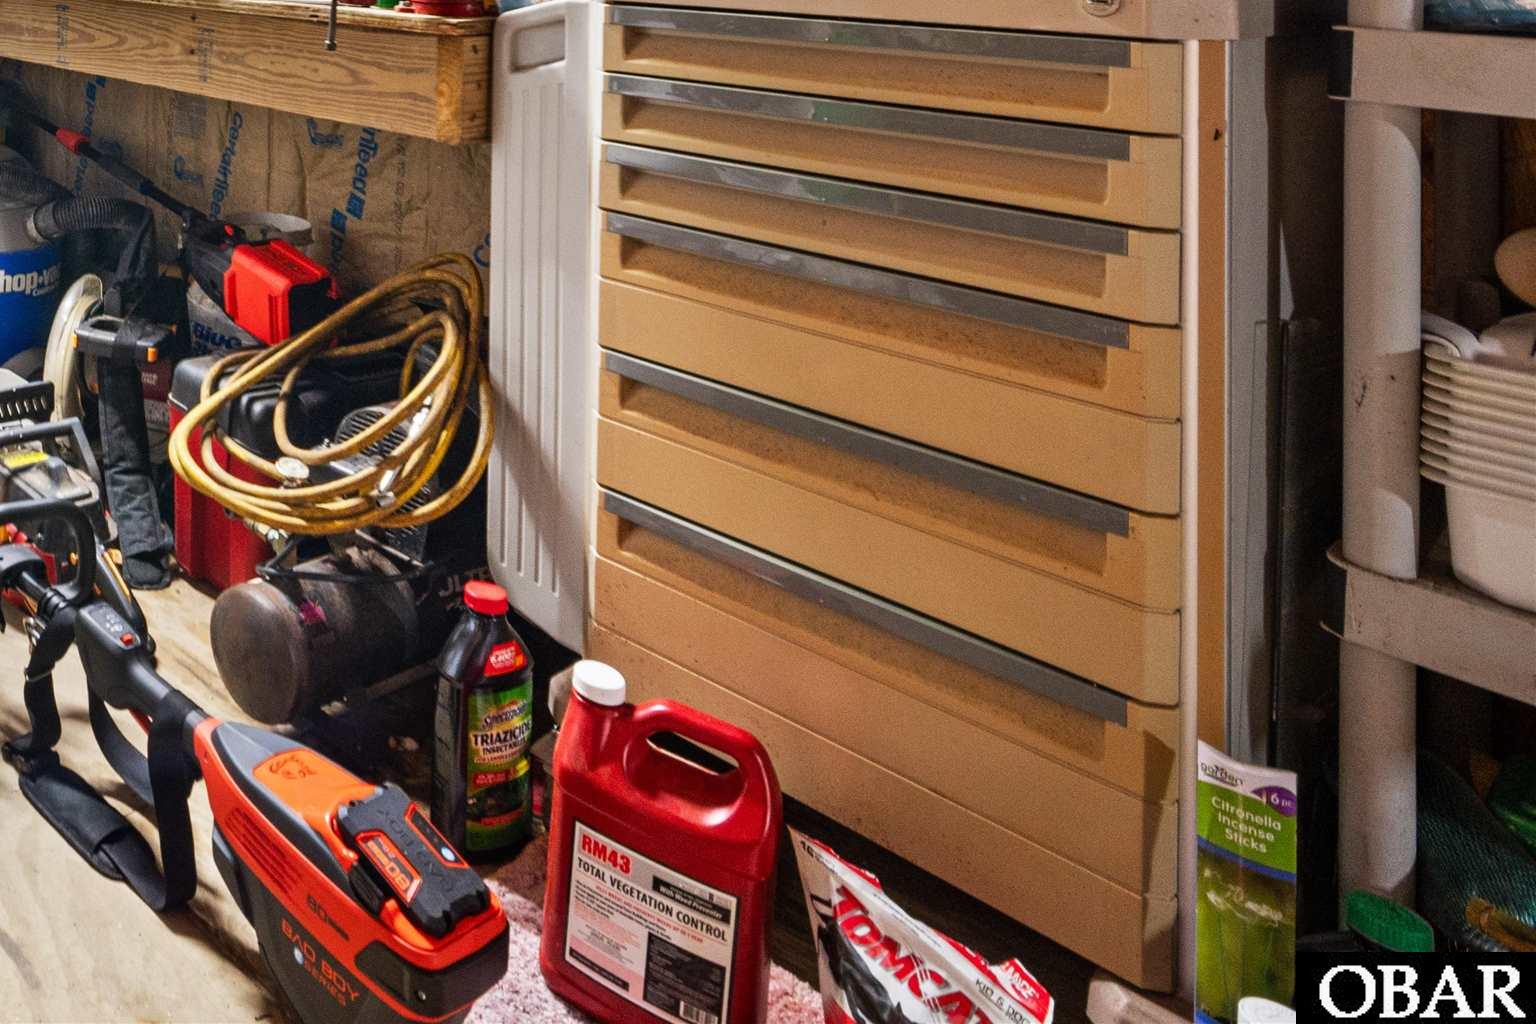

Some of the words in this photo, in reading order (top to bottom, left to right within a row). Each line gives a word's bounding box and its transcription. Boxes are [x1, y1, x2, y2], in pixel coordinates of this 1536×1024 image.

[208, 111, 244, 221] CertainTee
[1211, 794, 1283, 832] Citronella
[1270, 791, 1281, 806] 6
[1217, 813, 1276, 843] Incense
[1224, 826, 1268, 854] Sticks
[581, 833, 632, 875] RM43
[577, 856, 607, 884] TOTAL
[609, 874, 674, 918] VEGETATION
[676, 910, 728, 943] CONTROL
[975, 978, 994, 998] KID
